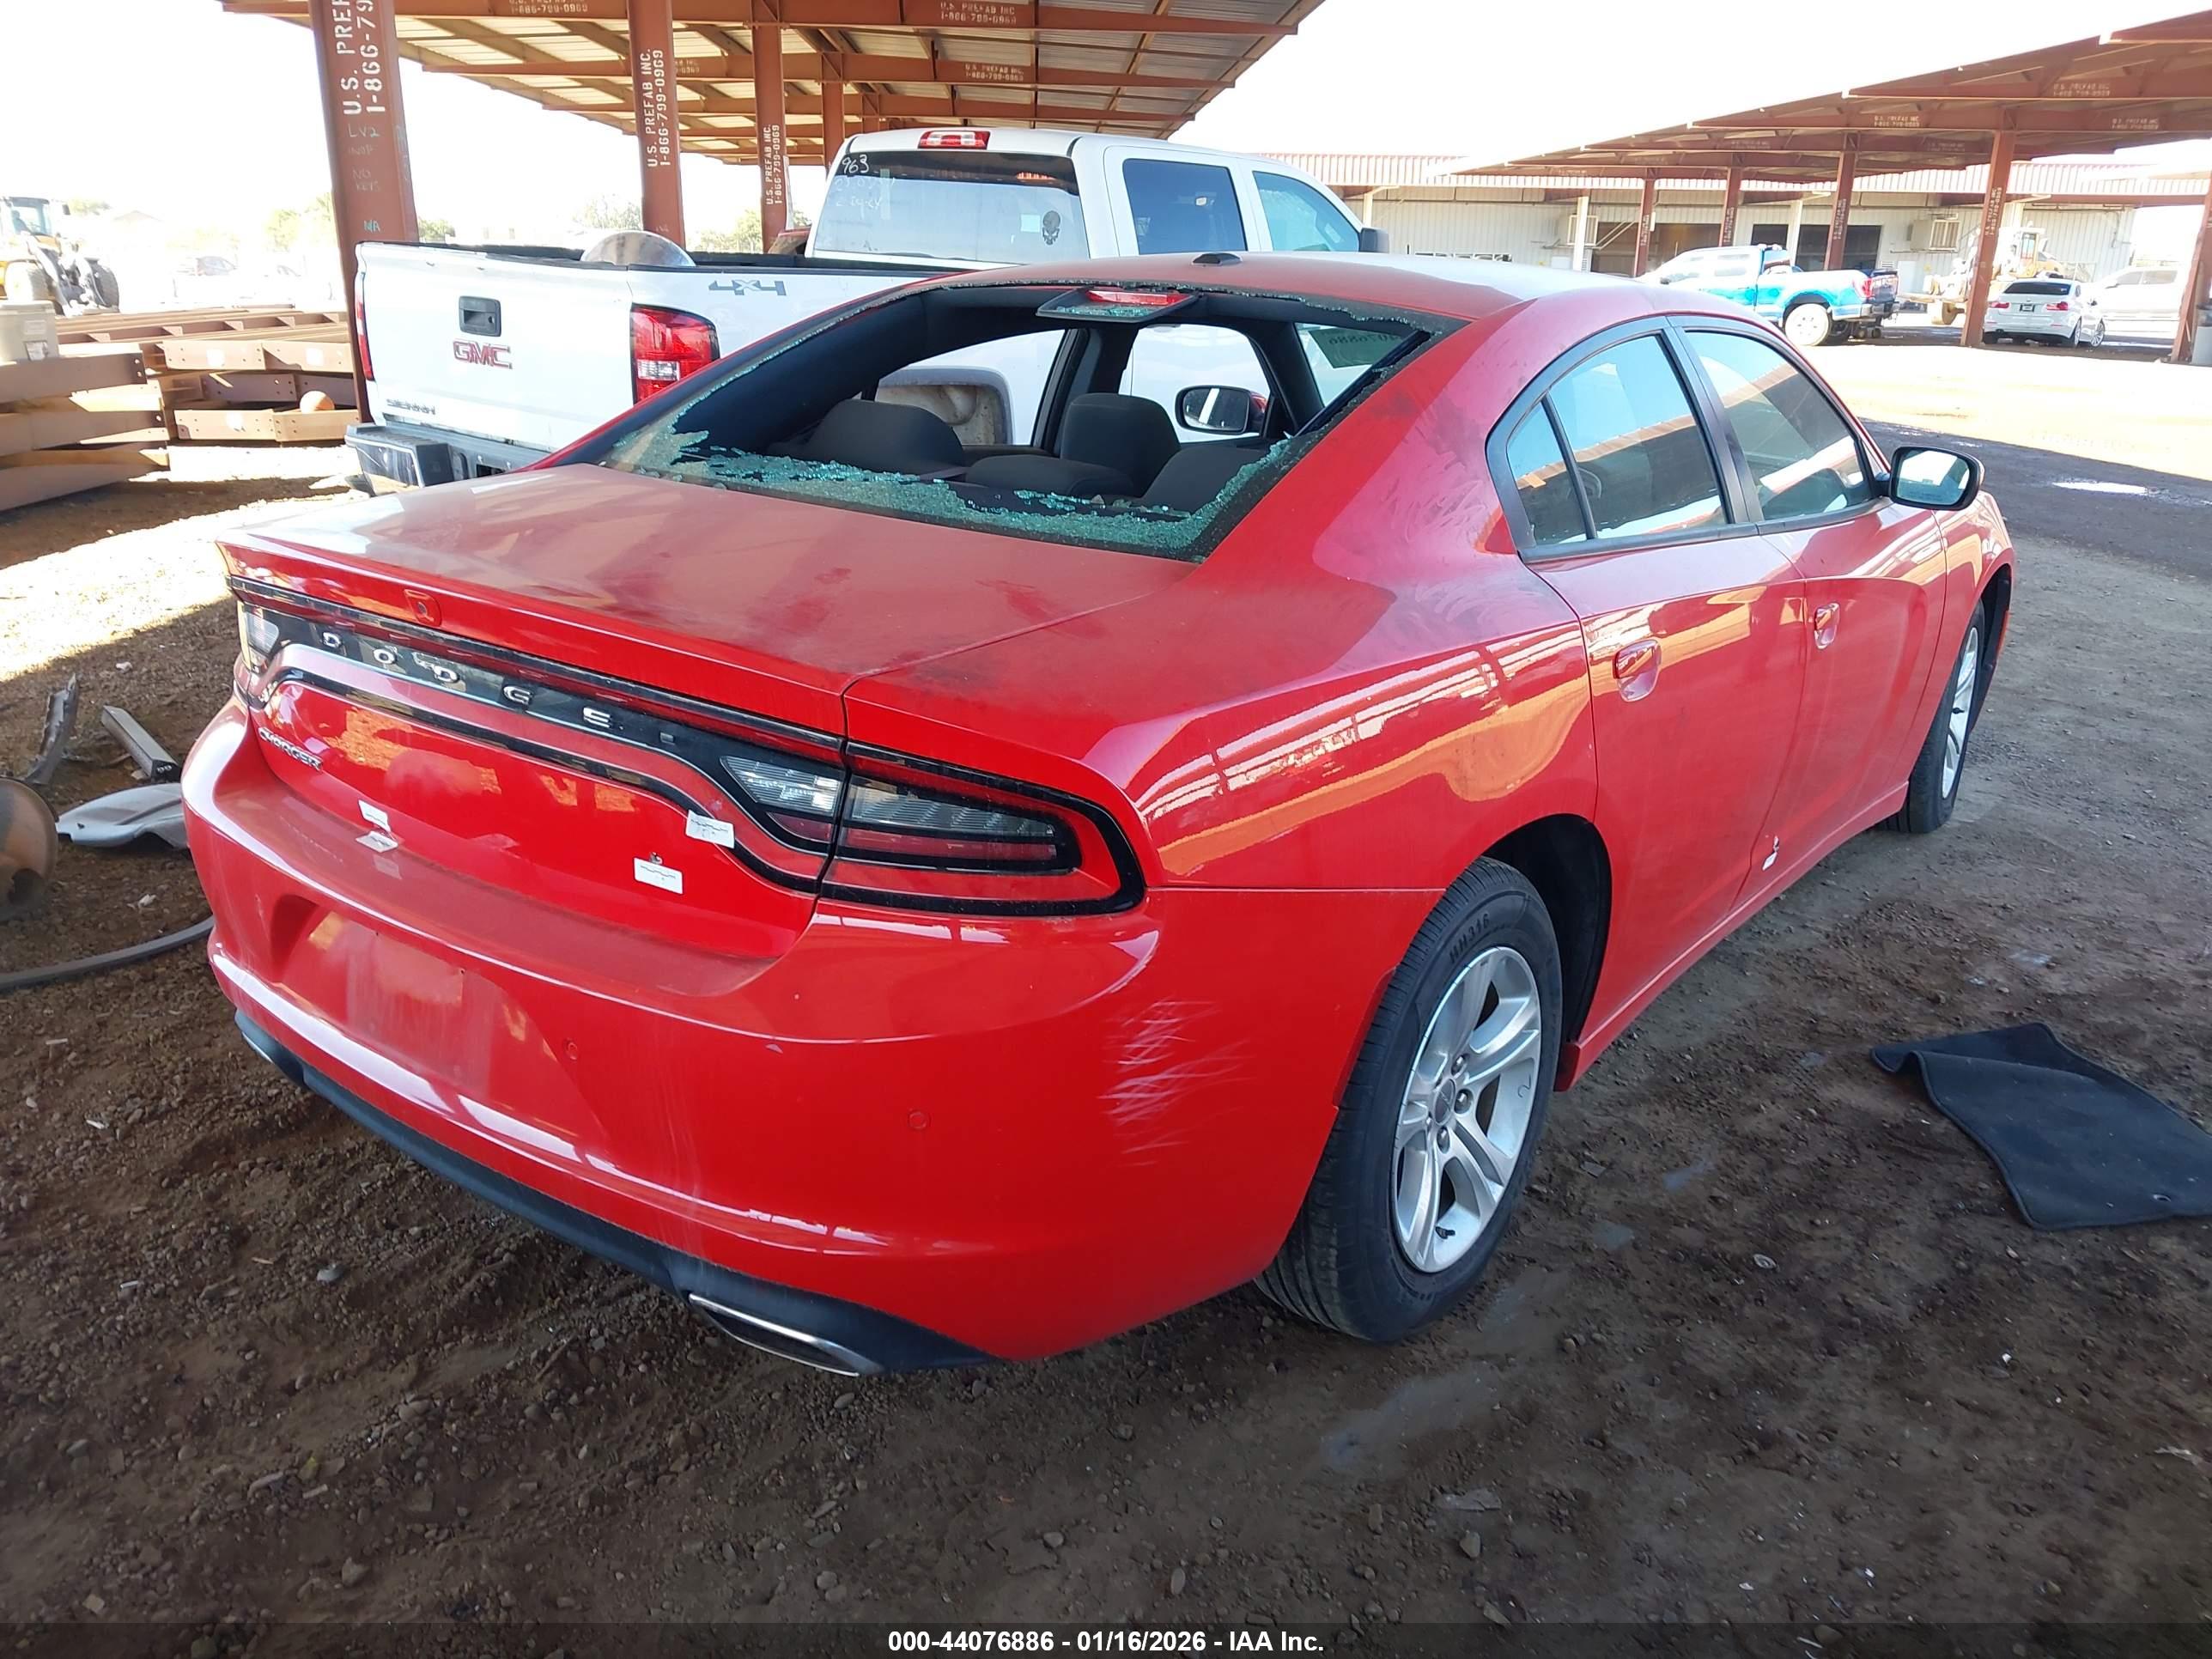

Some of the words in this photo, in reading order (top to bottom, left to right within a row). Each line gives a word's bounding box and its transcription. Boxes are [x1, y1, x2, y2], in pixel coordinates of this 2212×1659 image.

[640, 49, 653, 75] INC.
[341, 70, 362, 115] U.S.
[641, 82, 657, 134] PREFAB
[653, 50, 671, 166] 1-866-799-0969
[647, 142, 659, 167] U.S.
[763, 146, 773, 183] PREFAB
[842, 154, 870, 174] 963
[765, 186, 774, 205] U.S.
[453, 338, 514, 370] GMC
[322, 631, 611, 730] DODGE
[258, 726, 324, 772] CHARGER
